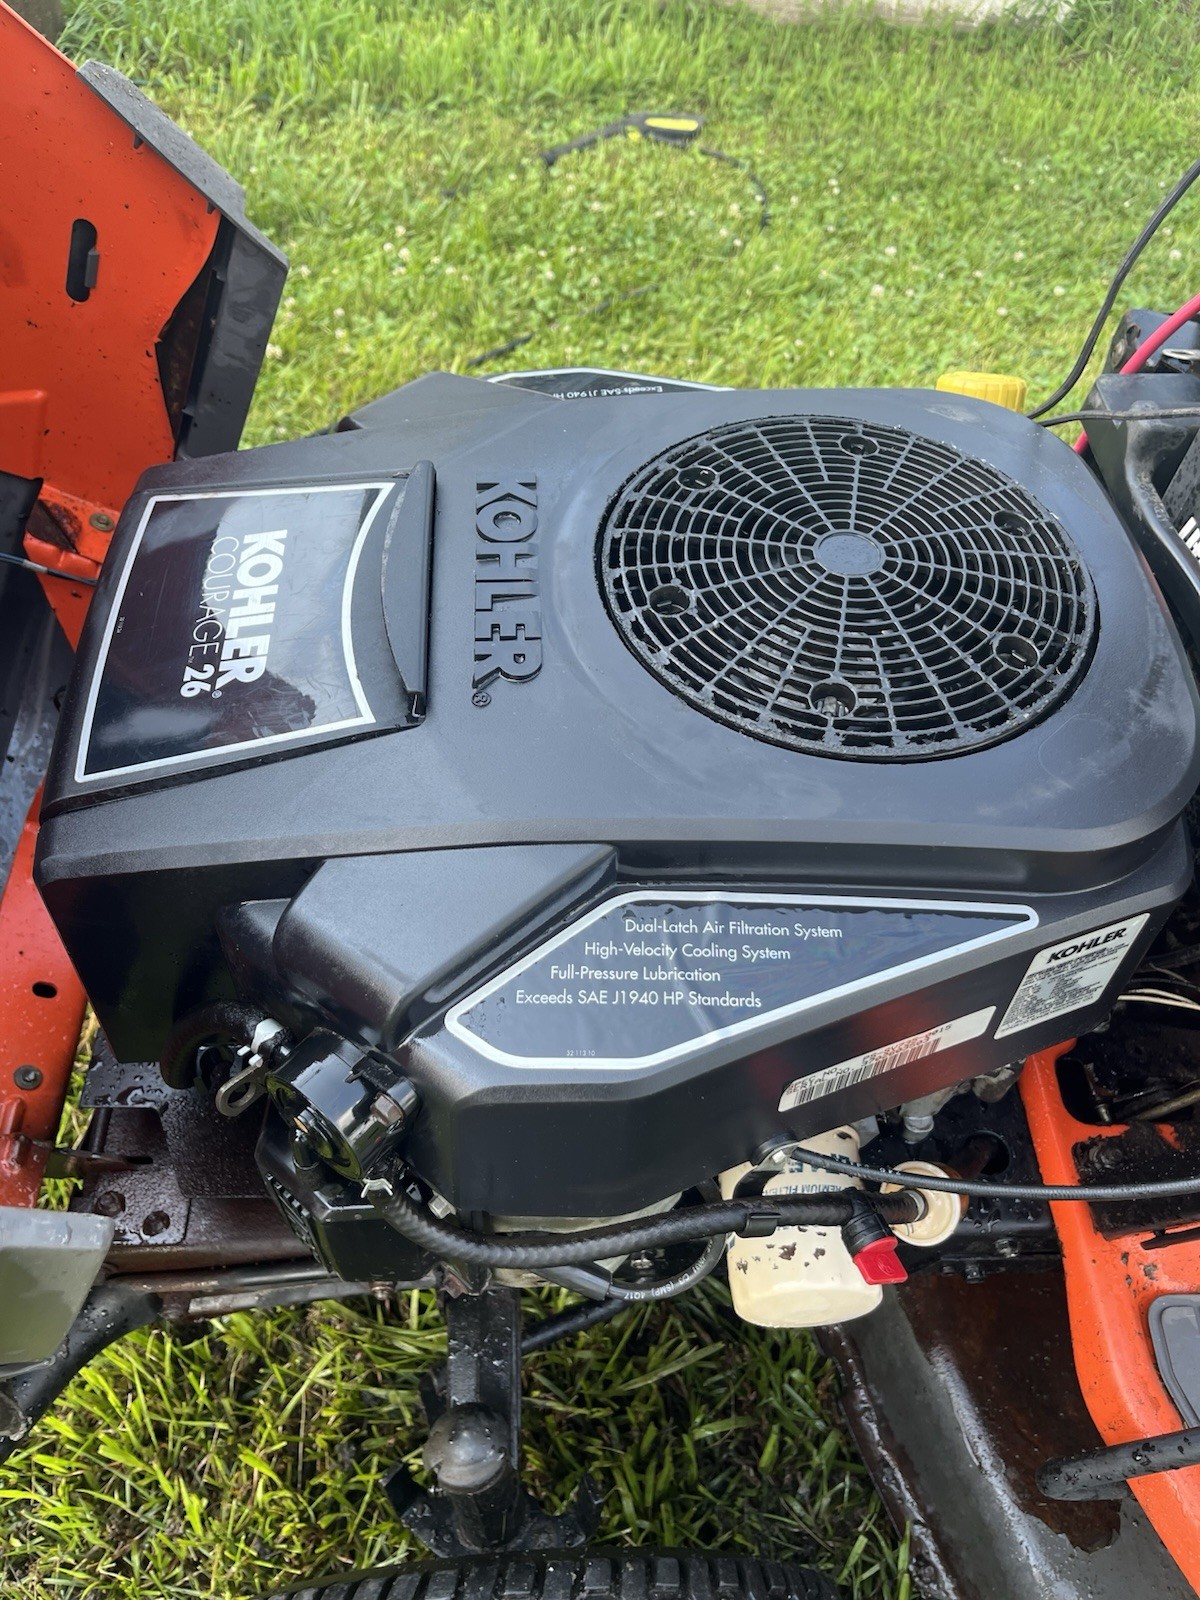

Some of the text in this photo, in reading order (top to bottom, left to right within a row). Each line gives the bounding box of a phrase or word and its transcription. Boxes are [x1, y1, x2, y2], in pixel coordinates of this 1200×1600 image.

[566, 389, 598, 399] J1940
[600, 388, 621, 397] SAE
[624, 385, 663, 395] Exceeds
[473, 472, 543, 690] KOHLER
[180, 536, 239, 698] COURAGE 26
[215, 529, 288, 690] KOHLER
[625, 919, 843, 941] Dual-Latch Air Filtration System
[584, 940, 791, 962] High-Velocity Cooling System
[1047, 927, 1128, 964] KOHLER
[550, 964, 721, 982] Full-Pressure Lubrication
[516, 988, 762, 1008] Exceeds SAE J1940 HP Standards
[802, 1183, 843, 1195] REMIUM
